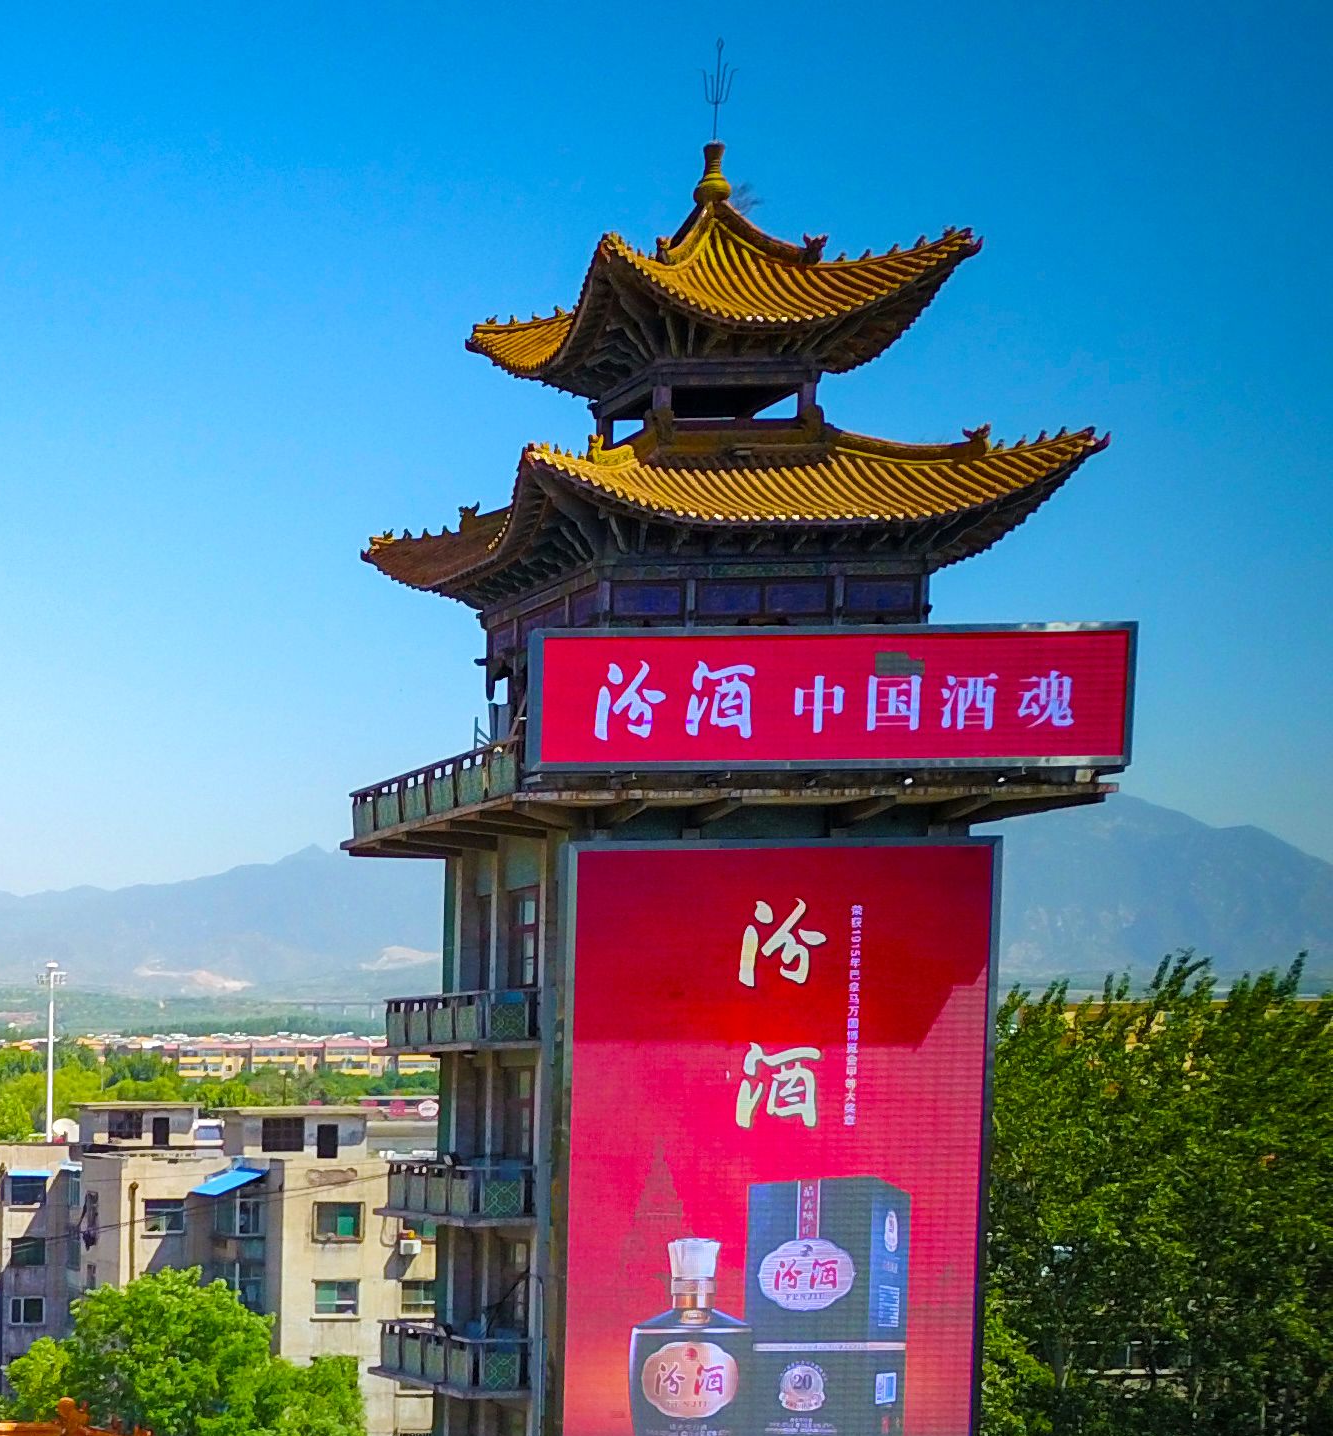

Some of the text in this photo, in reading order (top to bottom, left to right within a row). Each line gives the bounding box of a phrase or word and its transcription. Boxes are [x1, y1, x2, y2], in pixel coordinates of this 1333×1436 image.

[593, 659, 1074, 742] 汾酒 中国酒魂
[735, 896, 826, 1129] 汾酒
[773, 1258, 839, 1291] 汾酒
[654, 1363, 724, 1396] 汾酒
[793, 1374, 813, 1390] 20
